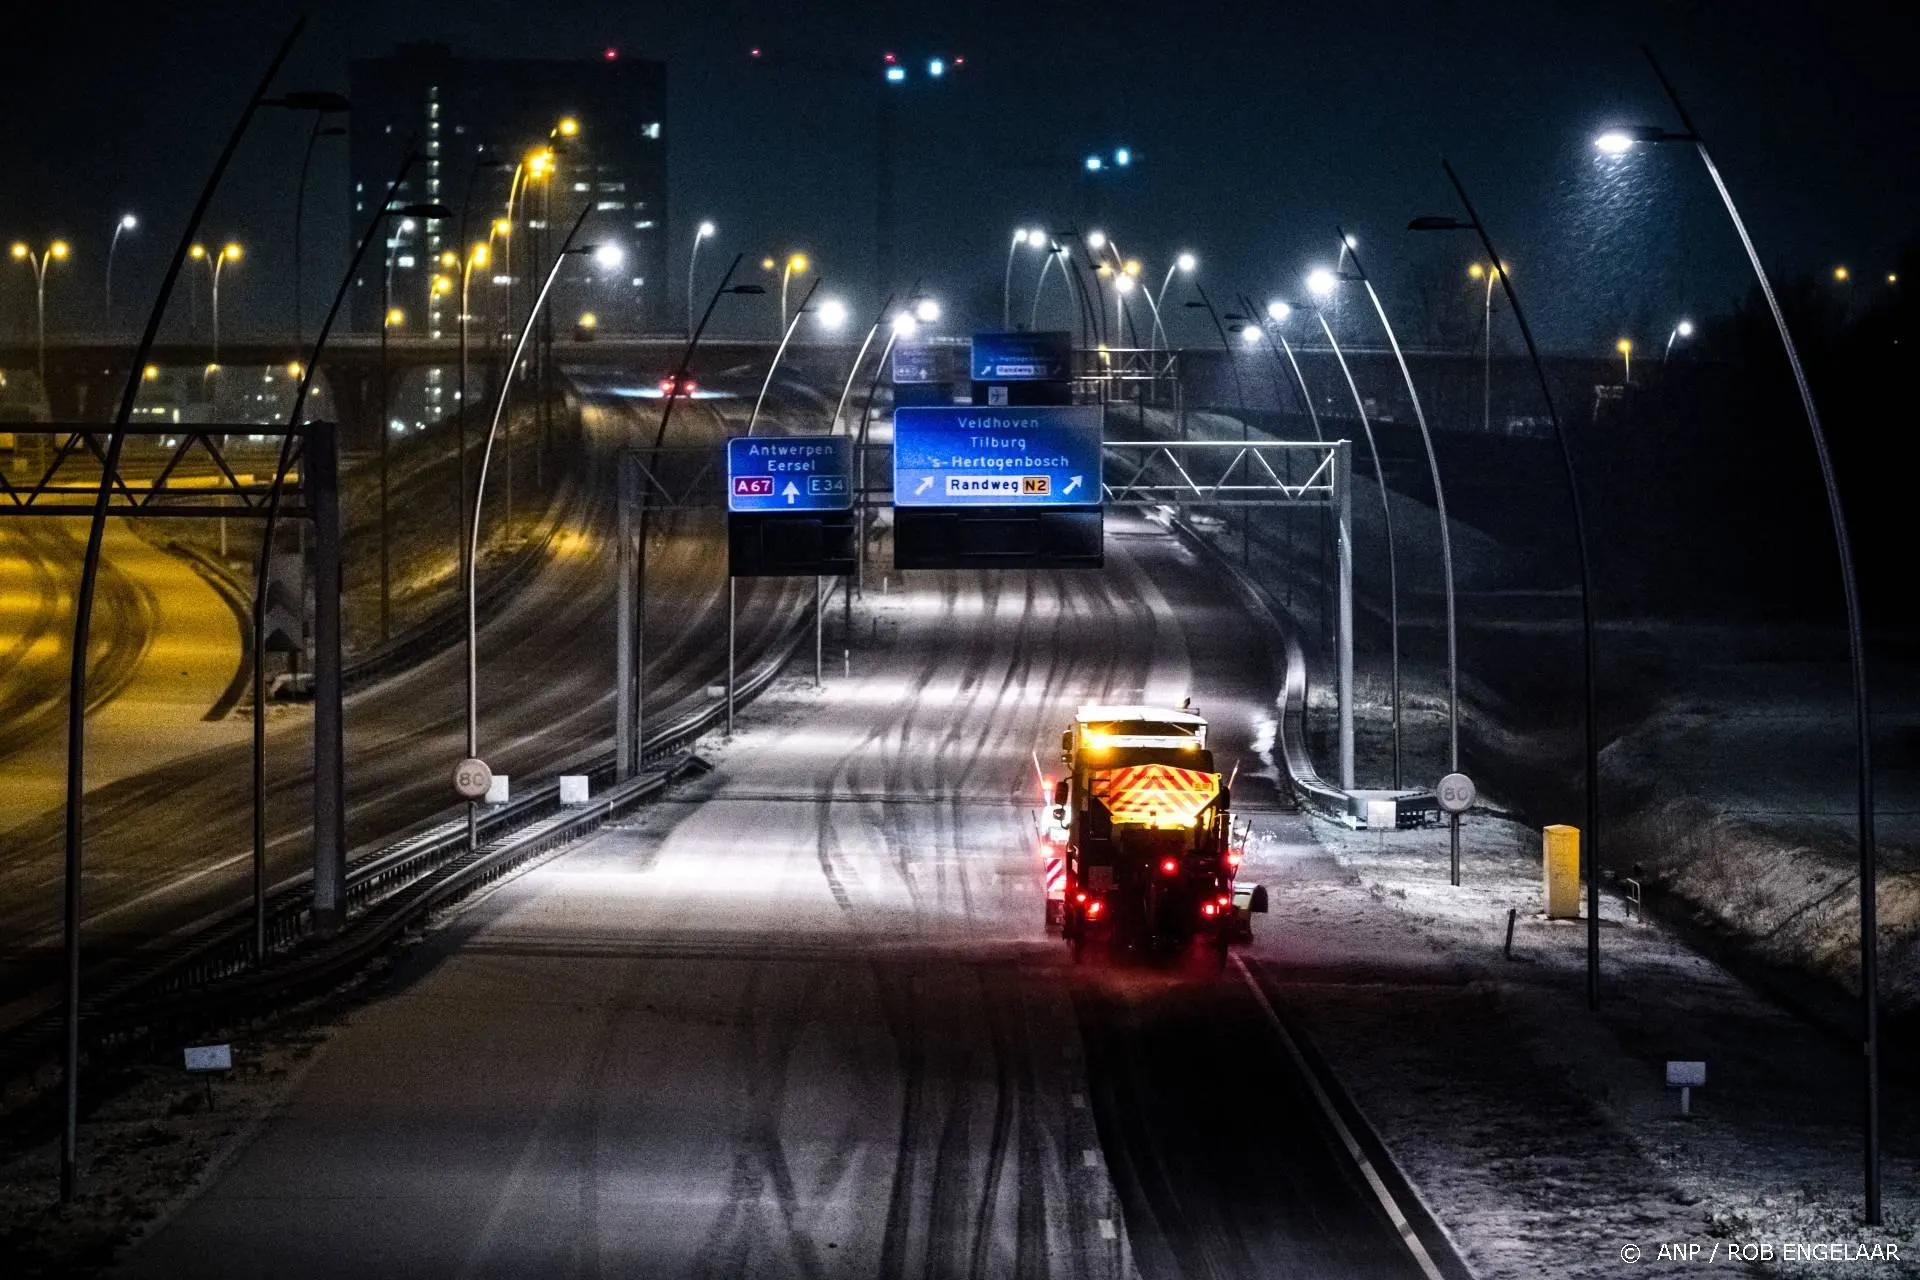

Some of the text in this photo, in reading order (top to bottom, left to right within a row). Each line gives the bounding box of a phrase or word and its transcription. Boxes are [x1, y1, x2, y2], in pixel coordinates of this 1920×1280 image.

[957, 416, 1040, 429] Veldhoven
[970, 436, 1027, 451] Tilburg
[748, 444, 834, 457] Antwerpen
[767, 460, 816, 472] Eersel
[927, 456, 1070, 471] 's-Hertogenbosch
[737, 479, 844, 492] A67 E34
[951, 479, 1048, 492] Randweg N2
